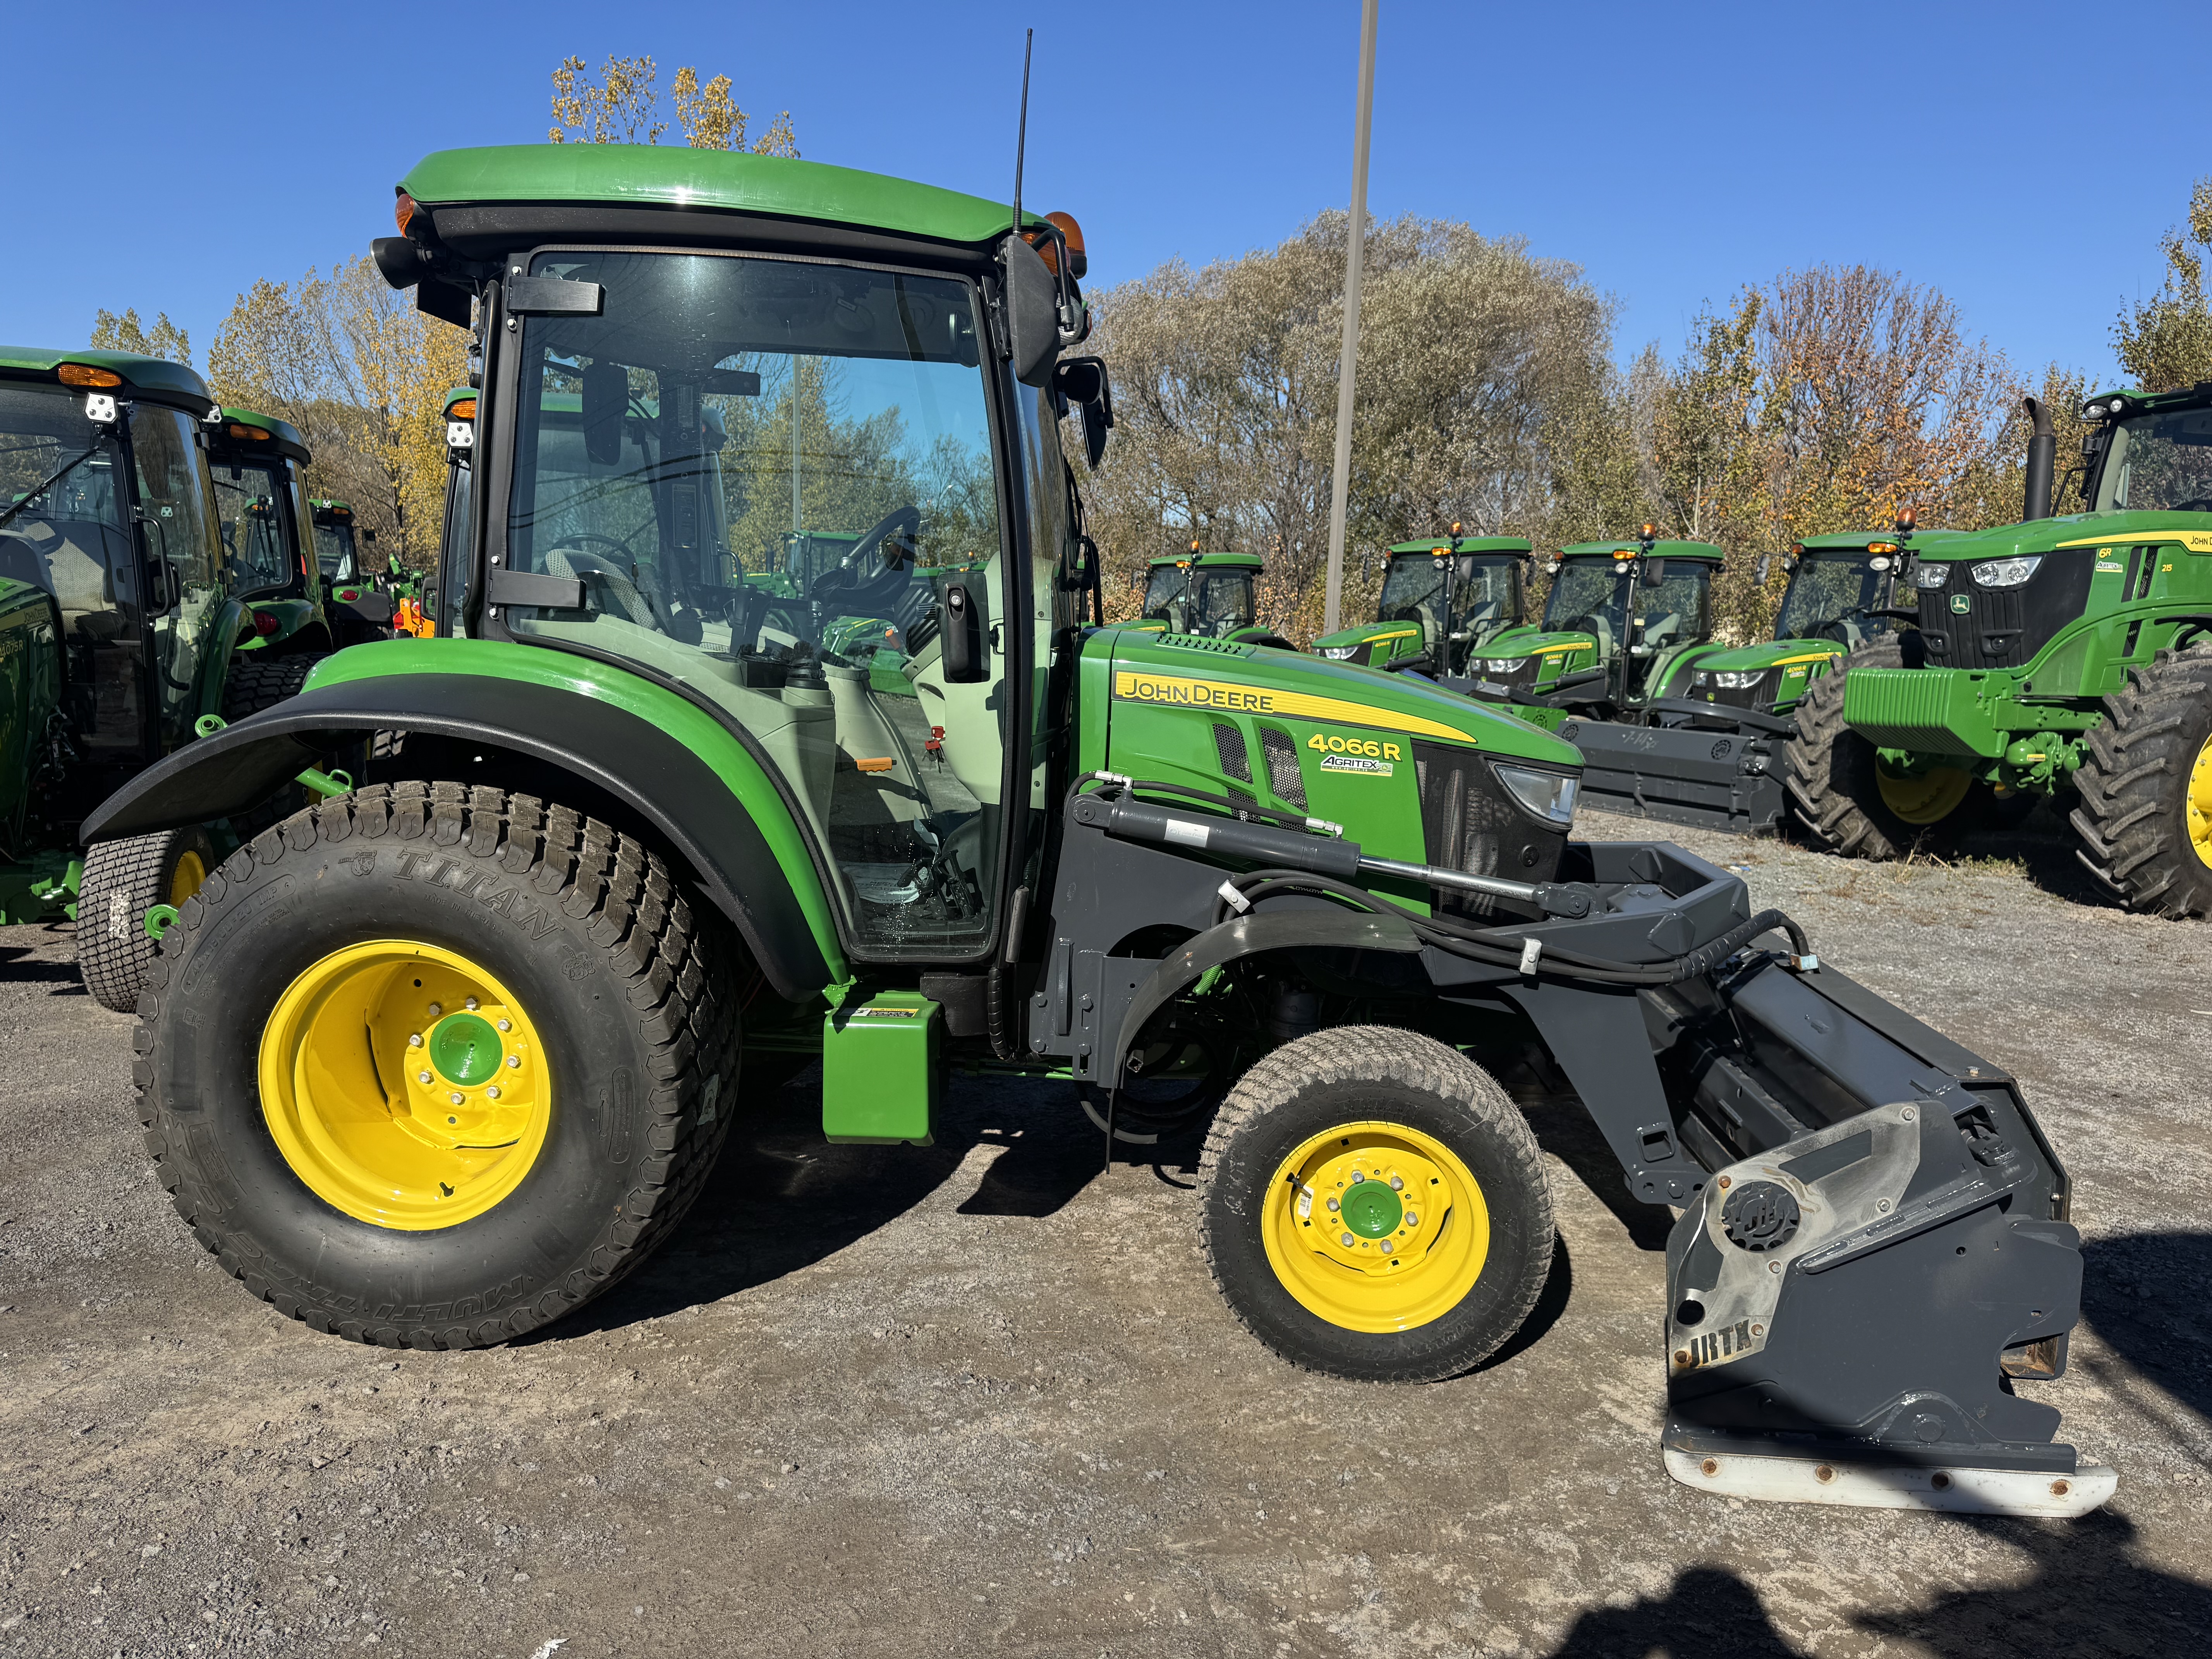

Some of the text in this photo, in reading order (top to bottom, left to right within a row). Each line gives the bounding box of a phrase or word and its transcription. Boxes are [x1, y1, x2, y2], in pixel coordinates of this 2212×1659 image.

[2191, 536, 2207, 545] JOHN
[2099, 548, 2112, 558] 6R
[24, 607, 48, 623] JOHN DEERE
[1125, 679, 1273, 711] JOHN DEERE
[1323, 756, 1377, 769] AGRITEX
[392, 847, 566, 941] TITAN
[424, 893, 447, 905] MADE
[452, 902, 460, 911] IN
[1334, 1097, 1425, 1119] TITAN
[225, 1231, 357, 1314] TRAC
[372, 1274, 524, 1322] MULTI
